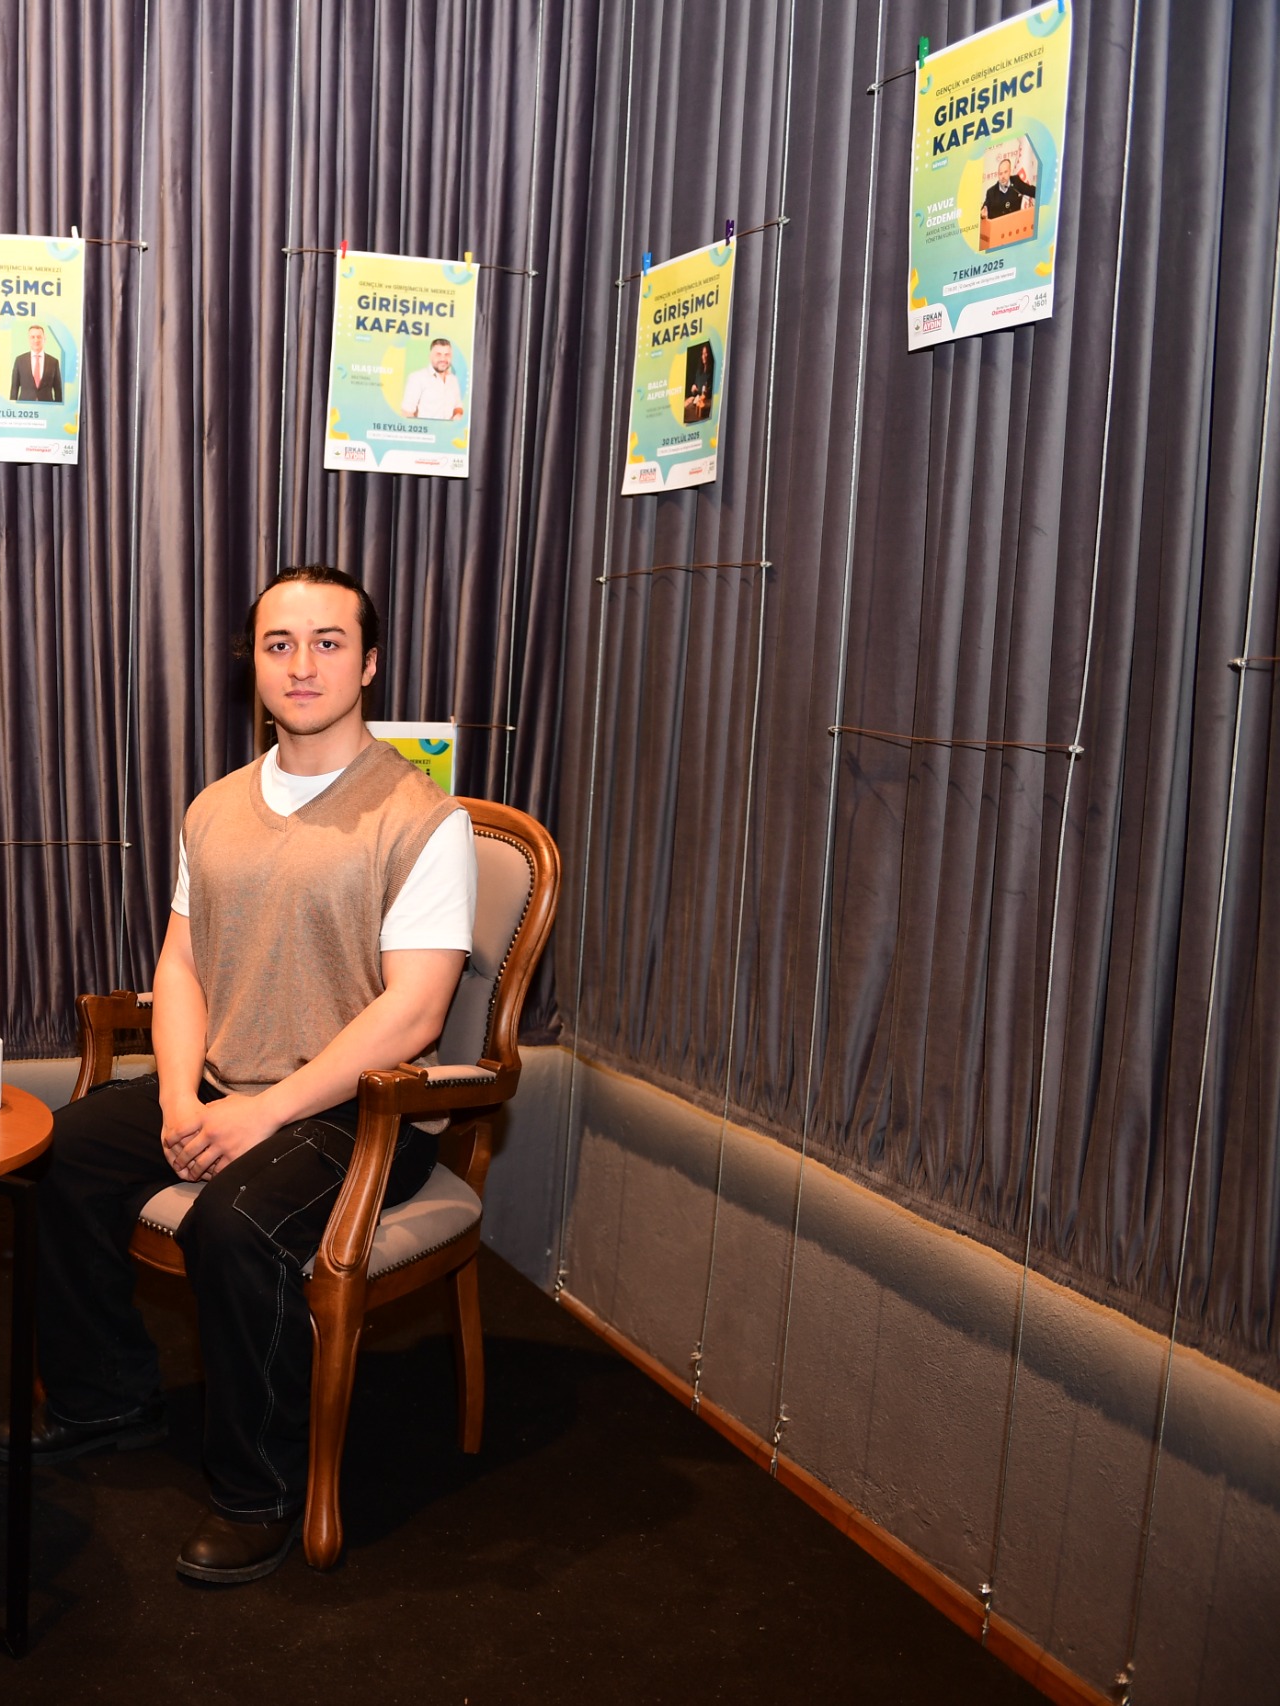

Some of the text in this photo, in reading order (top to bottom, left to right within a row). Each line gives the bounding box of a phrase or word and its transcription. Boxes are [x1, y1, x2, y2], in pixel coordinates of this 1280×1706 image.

[936, 80, 960, 96] GENÇLİK
[971, 59, 1012, 81] GİRİŞİMCİLİK
[1014, 46, 1044, 63] MERKEZİ
[934, 61, 1043, 126] GİRİŞİMCİ
[933, 107, 1012, 156] KAFASI
[927, 197, 954, 214] YAVUZ
[926, 208, 962, 228] ÖZDEMİR
[953, 259, 1004, 281] 7 EKİM 2025
[358, 292, 454, 318] GİRİŞİMCİ
[653, 284, 719, 325] GİRİŞİMCİ
[992, 305, 1020, 316] Osmangazi
[1035, 299, 1047, 308] 1601
[356, 316, 429, 336] KAFASI
[923, 311, 942, 321] ERKAN
[923, 320, 941, 331] AYDIN
[652, 317, 703, 347] KAFASI
[19, 411, 39, 419] 2025
[383, 423, 406, 432] EYLÜL
[408, 425, 428, 433] 2025
[671, 434, 687, 445] EYLÜL
